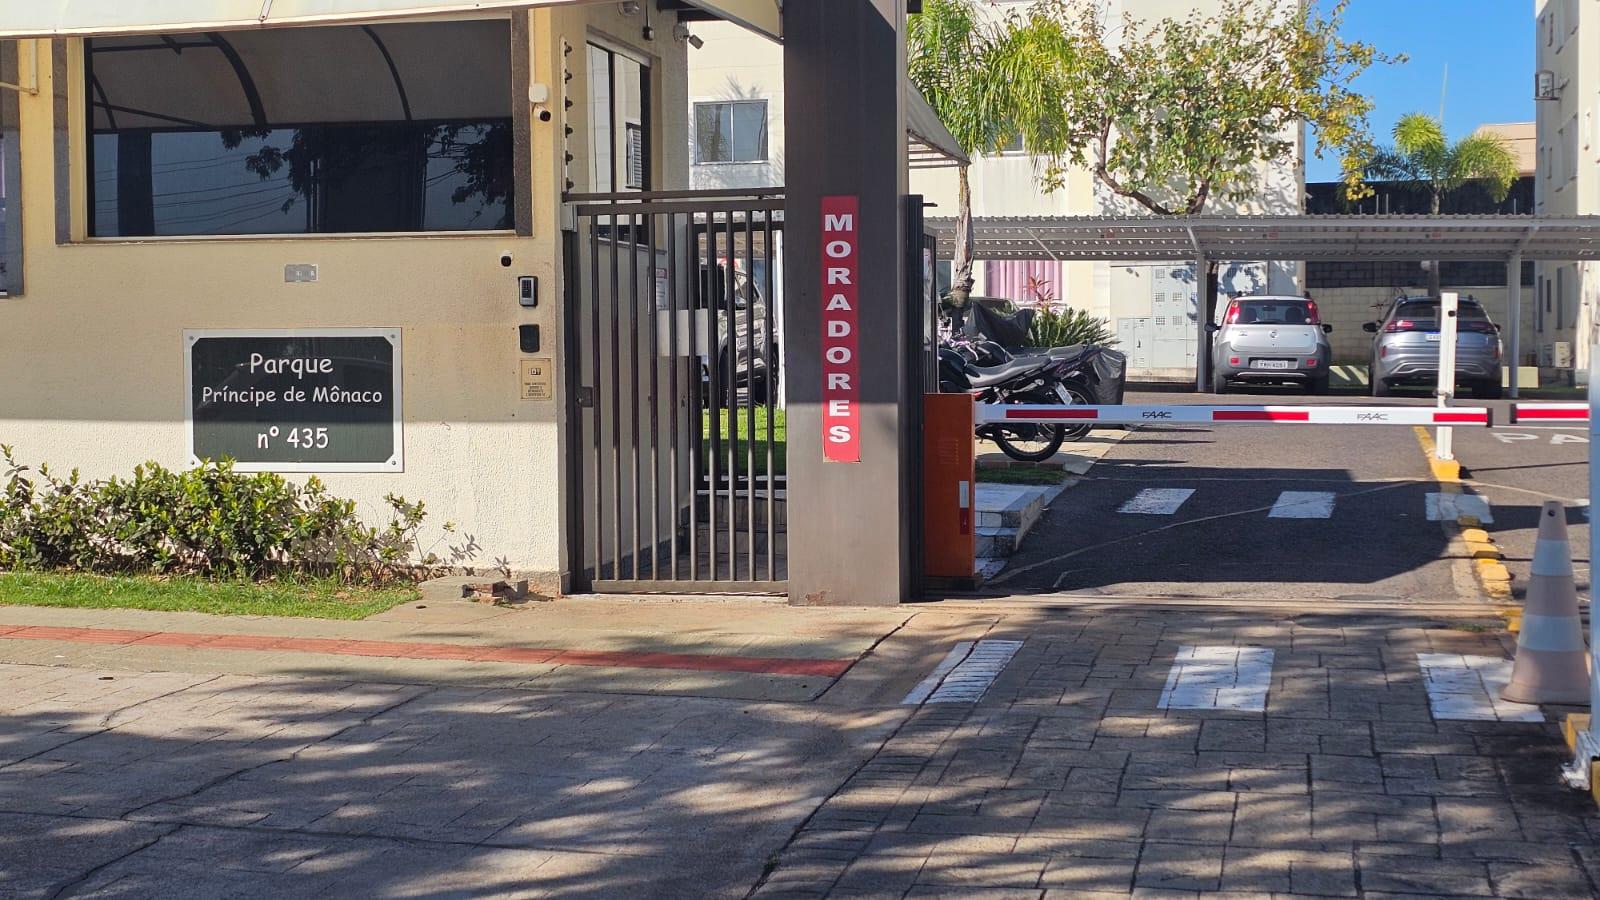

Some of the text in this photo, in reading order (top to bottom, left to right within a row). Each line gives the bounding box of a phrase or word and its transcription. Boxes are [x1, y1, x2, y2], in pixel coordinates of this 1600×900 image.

[824, 214, 853, 443] MORADORES
[250, 352, 334, 379] Parque
[202, 385, 383, 407] Príncipe de Mônaco
[1142, 410, 1173, 419] FAAC
[1356, 412, 1389, 421] FAAC
[286, 427, 330, 449] 435
